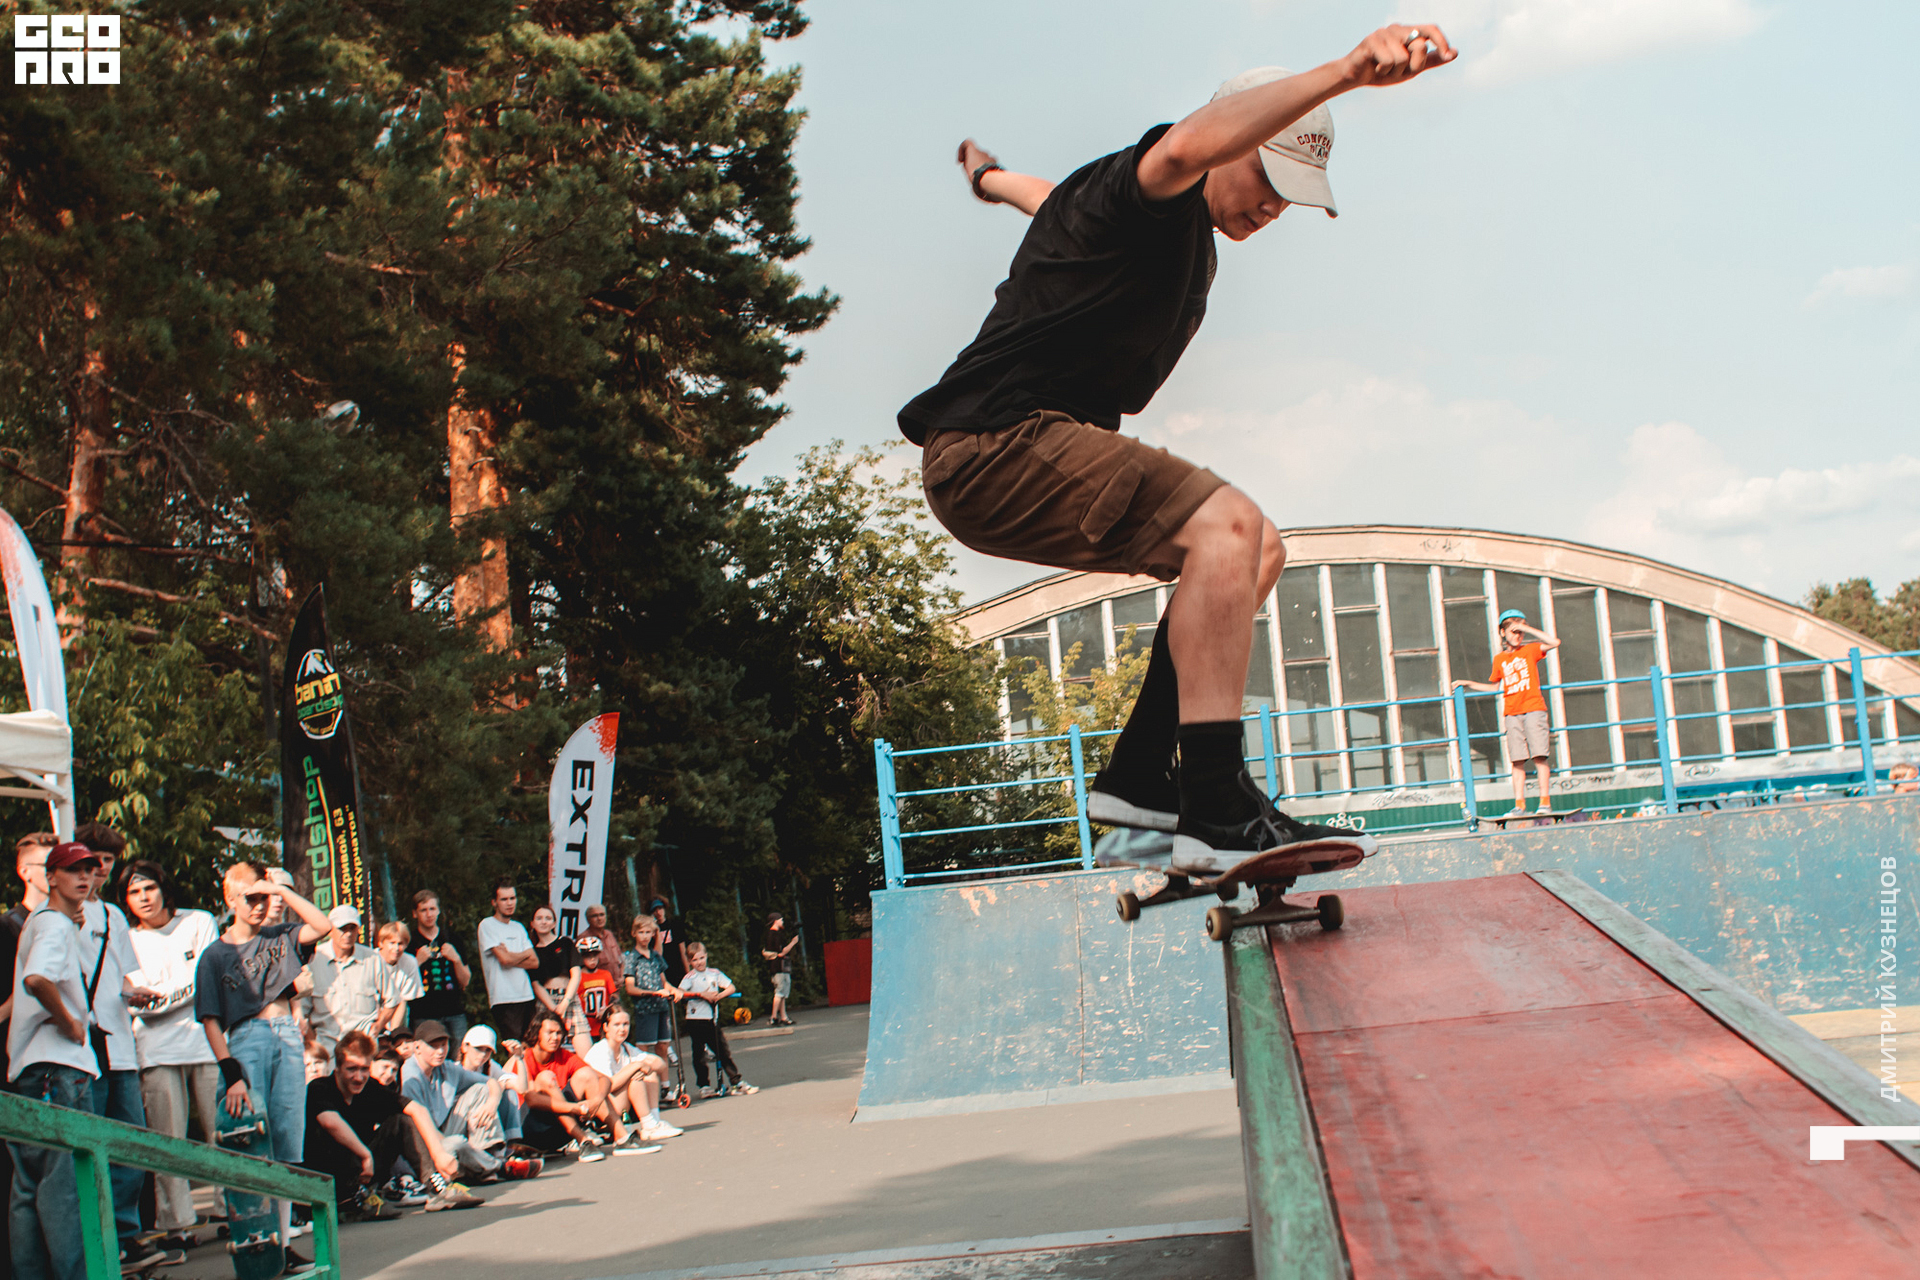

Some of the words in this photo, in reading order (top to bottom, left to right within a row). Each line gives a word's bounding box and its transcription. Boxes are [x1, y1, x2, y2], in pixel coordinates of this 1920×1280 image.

[295, 672, 341, 706] banan
[302, 754, 333, 918] ardshop
[333, 807, 345, 828] 63
[557, 759, 595, 940] EXTRE
